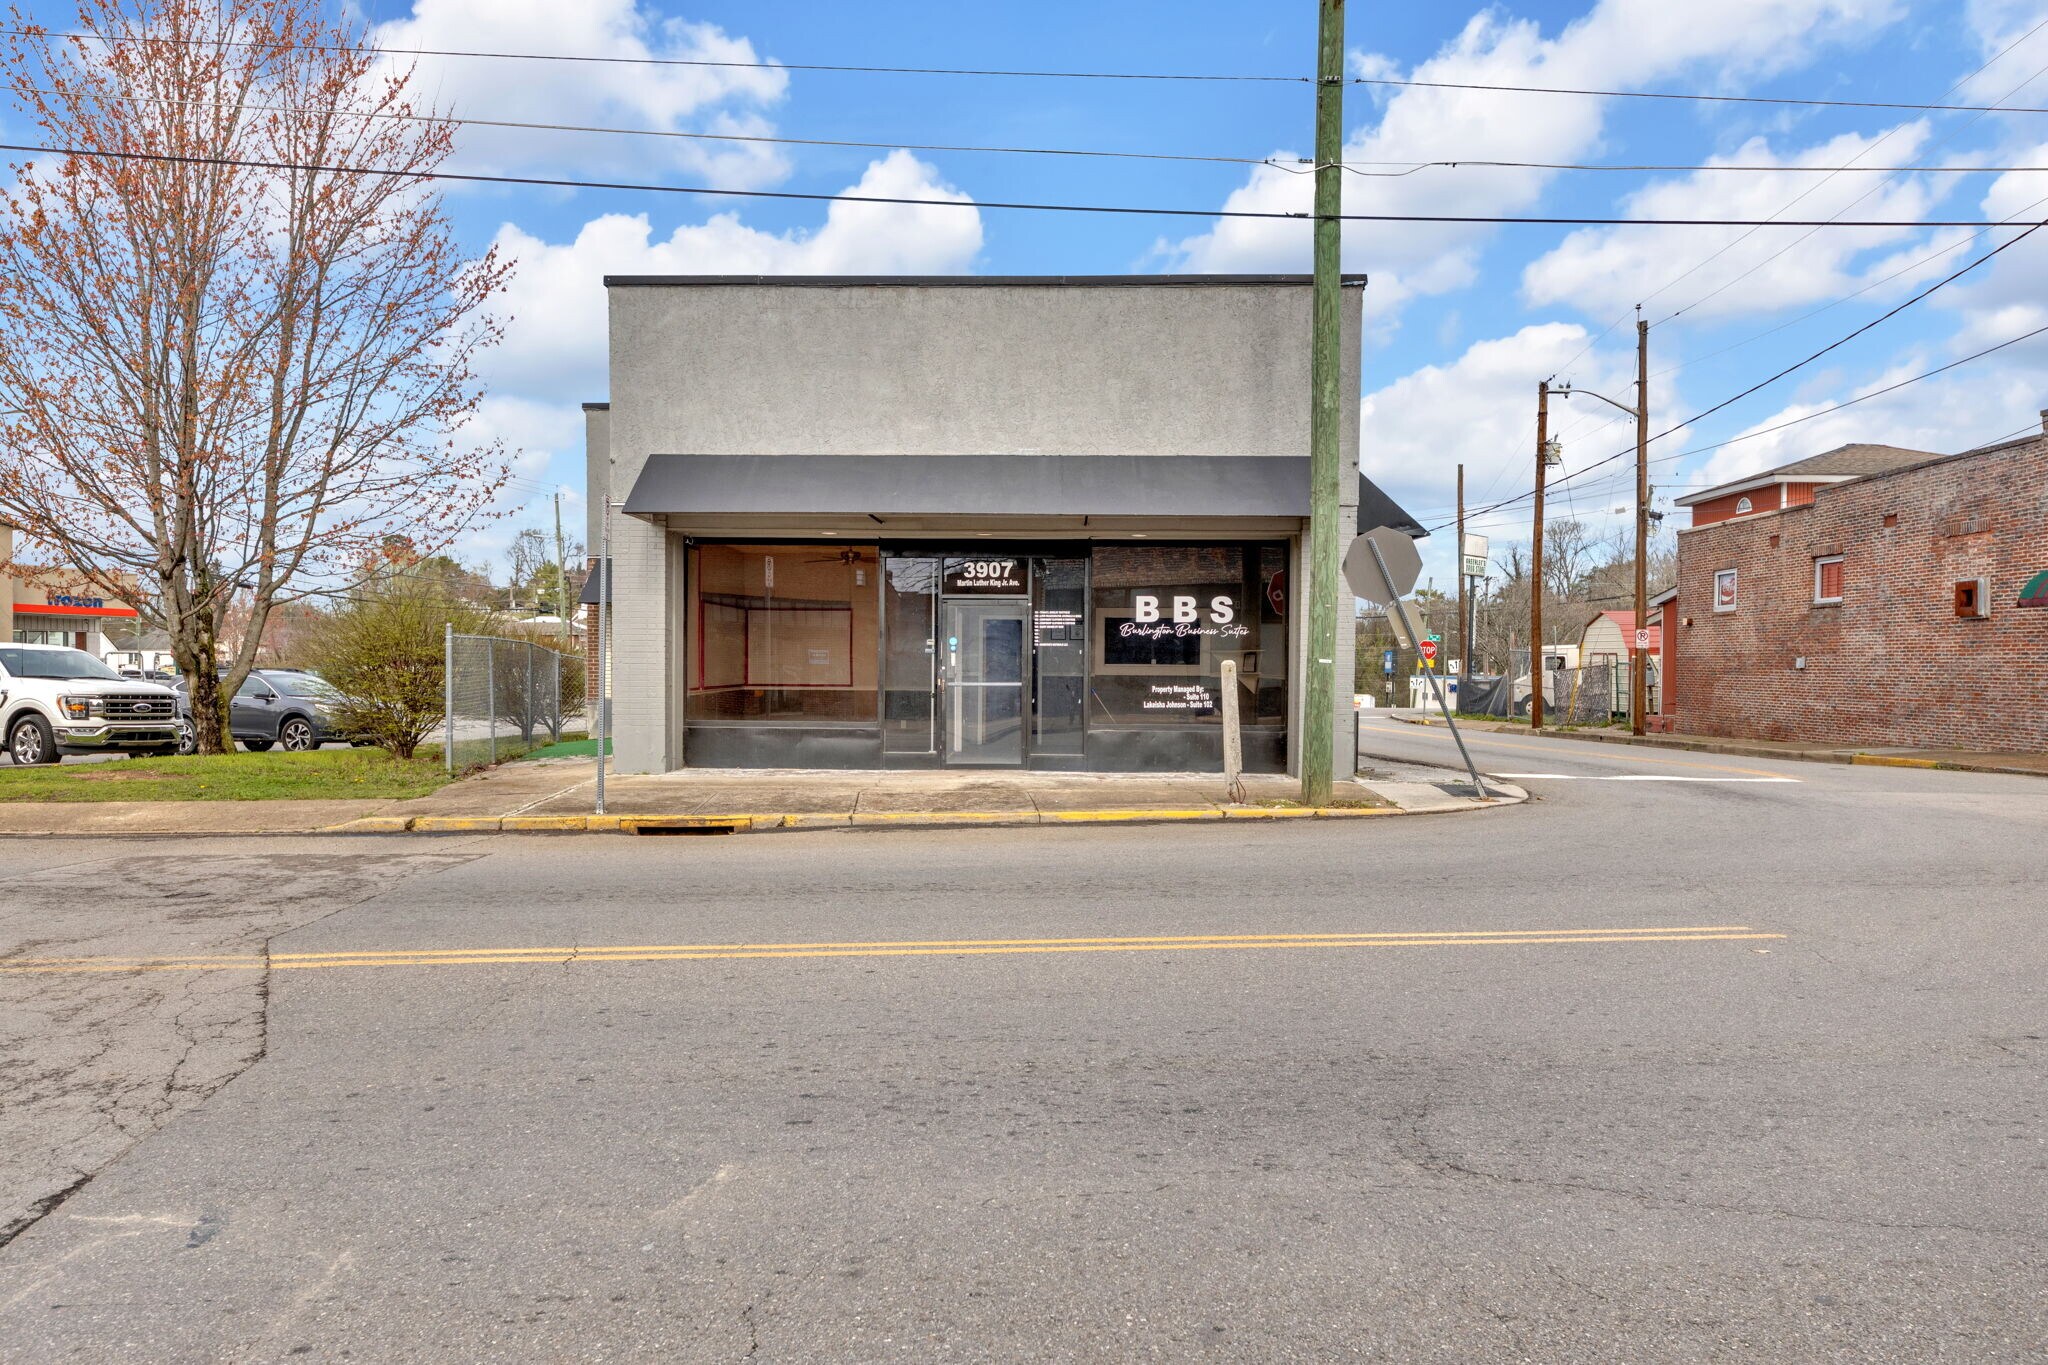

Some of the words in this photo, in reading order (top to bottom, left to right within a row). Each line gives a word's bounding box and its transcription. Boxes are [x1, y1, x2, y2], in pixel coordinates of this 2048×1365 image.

[963, 562, 1013, 578] 3907
[990, 579, 1001, 587] King
[48, 595, 103, 608] rozen
[1119, 623, 1174, 640] Burlington
[1175, 623, 1218, 638] Business
[1220, 624, 1249, 639] Suites
[1420, 646, 1436, 655] TOP
[1151, 685, 1173, 694] Property
[1173, 685, 1195, 694] Managed
[1196, 685, 1204, 694] By:
